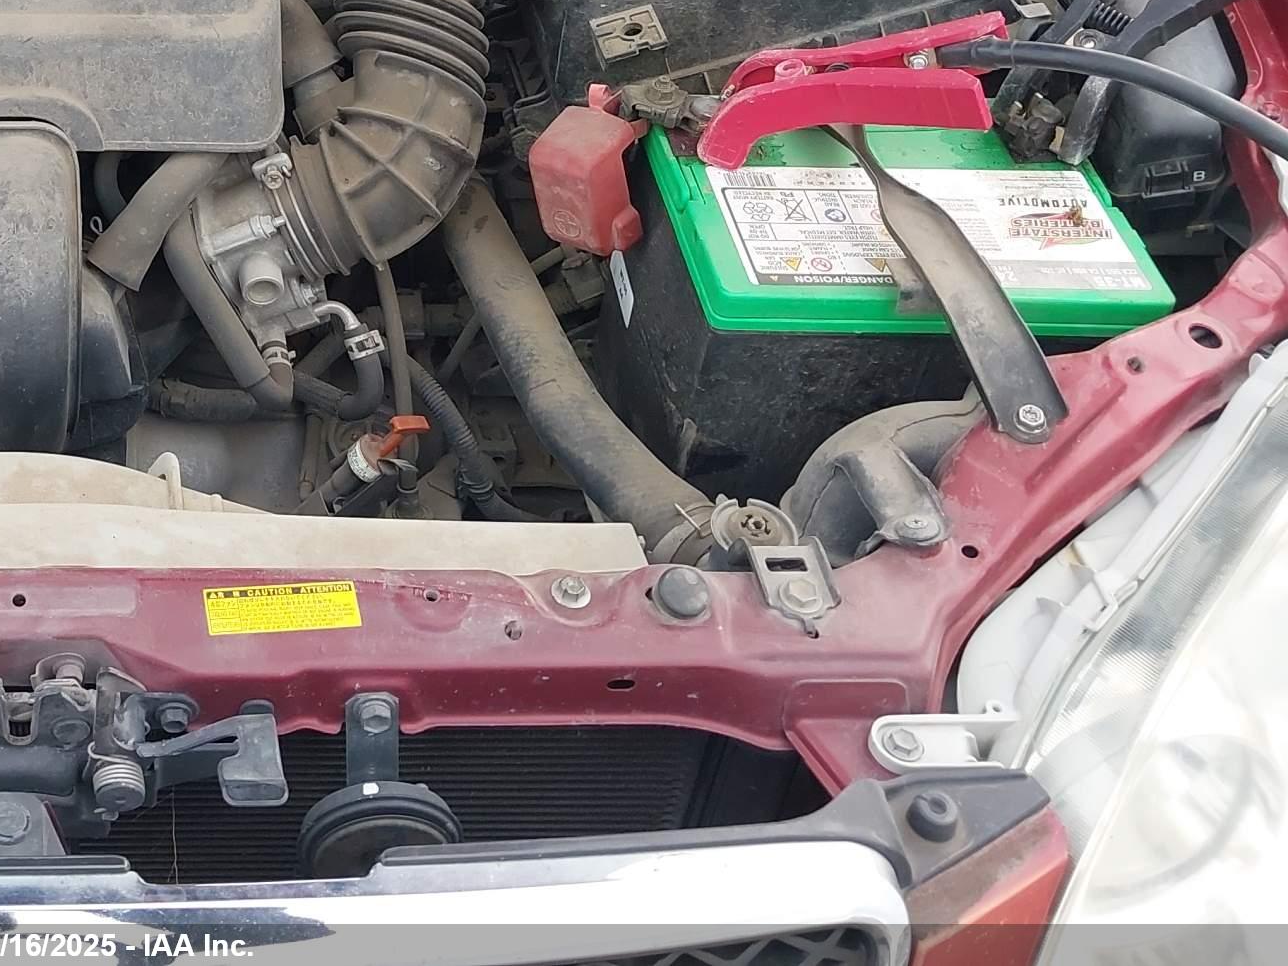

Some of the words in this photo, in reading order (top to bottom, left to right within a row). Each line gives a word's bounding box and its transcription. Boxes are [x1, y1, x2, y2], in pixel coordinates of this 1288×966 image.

[1193, 170, 1206, 182] B
[999, 198, 1088, 208] AUTOMOTIVE
[1012, 227, 1110, 238] INTERSTATE
[793, 275, 894, 284] DANGER/POISON
[247, 586, 293, 598] CAUTION
[300, 583, 350, 594] ATTENTION
